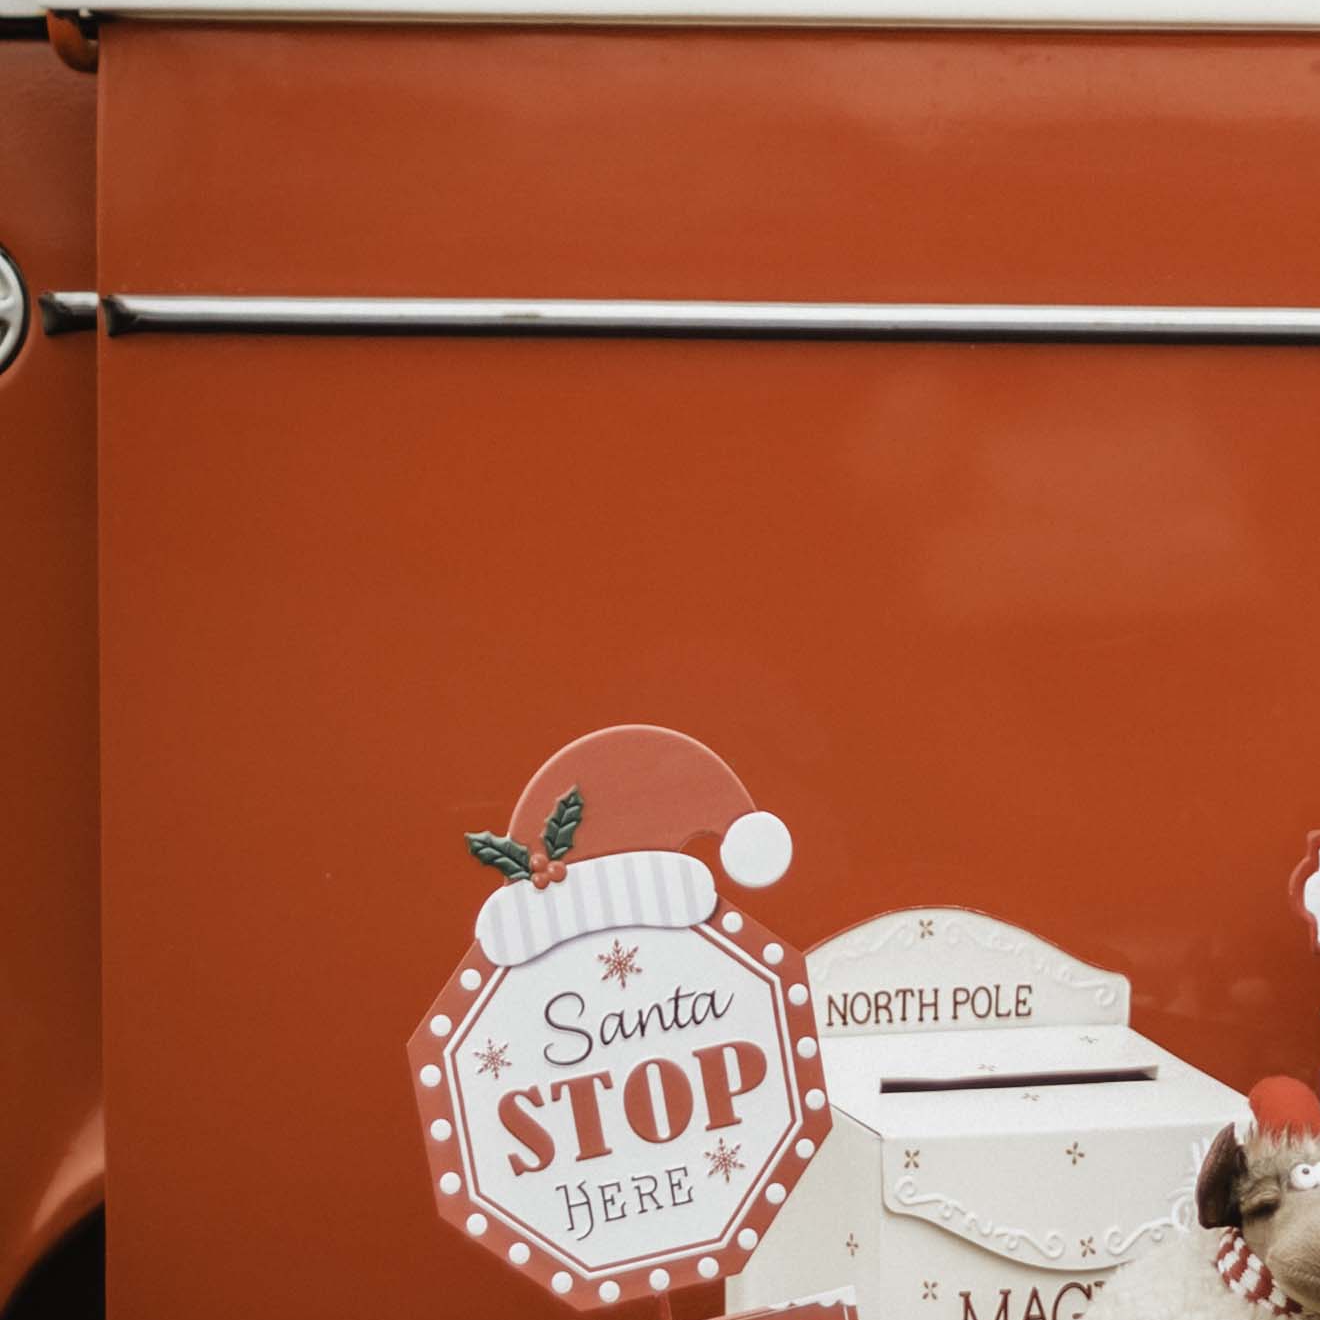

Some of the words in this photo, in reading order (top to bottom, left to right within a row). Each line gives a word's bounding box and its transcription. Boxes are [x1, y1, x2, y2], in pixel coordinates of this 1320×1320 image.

[543, 985, 735, 1067] Santa
[826, 987, 941, 1027] NORTH
[950, 984, 1034, 1022] POLE
[497, 1040, 768, 1177] STOP
[554, 1165, 694, 1242] HERE
